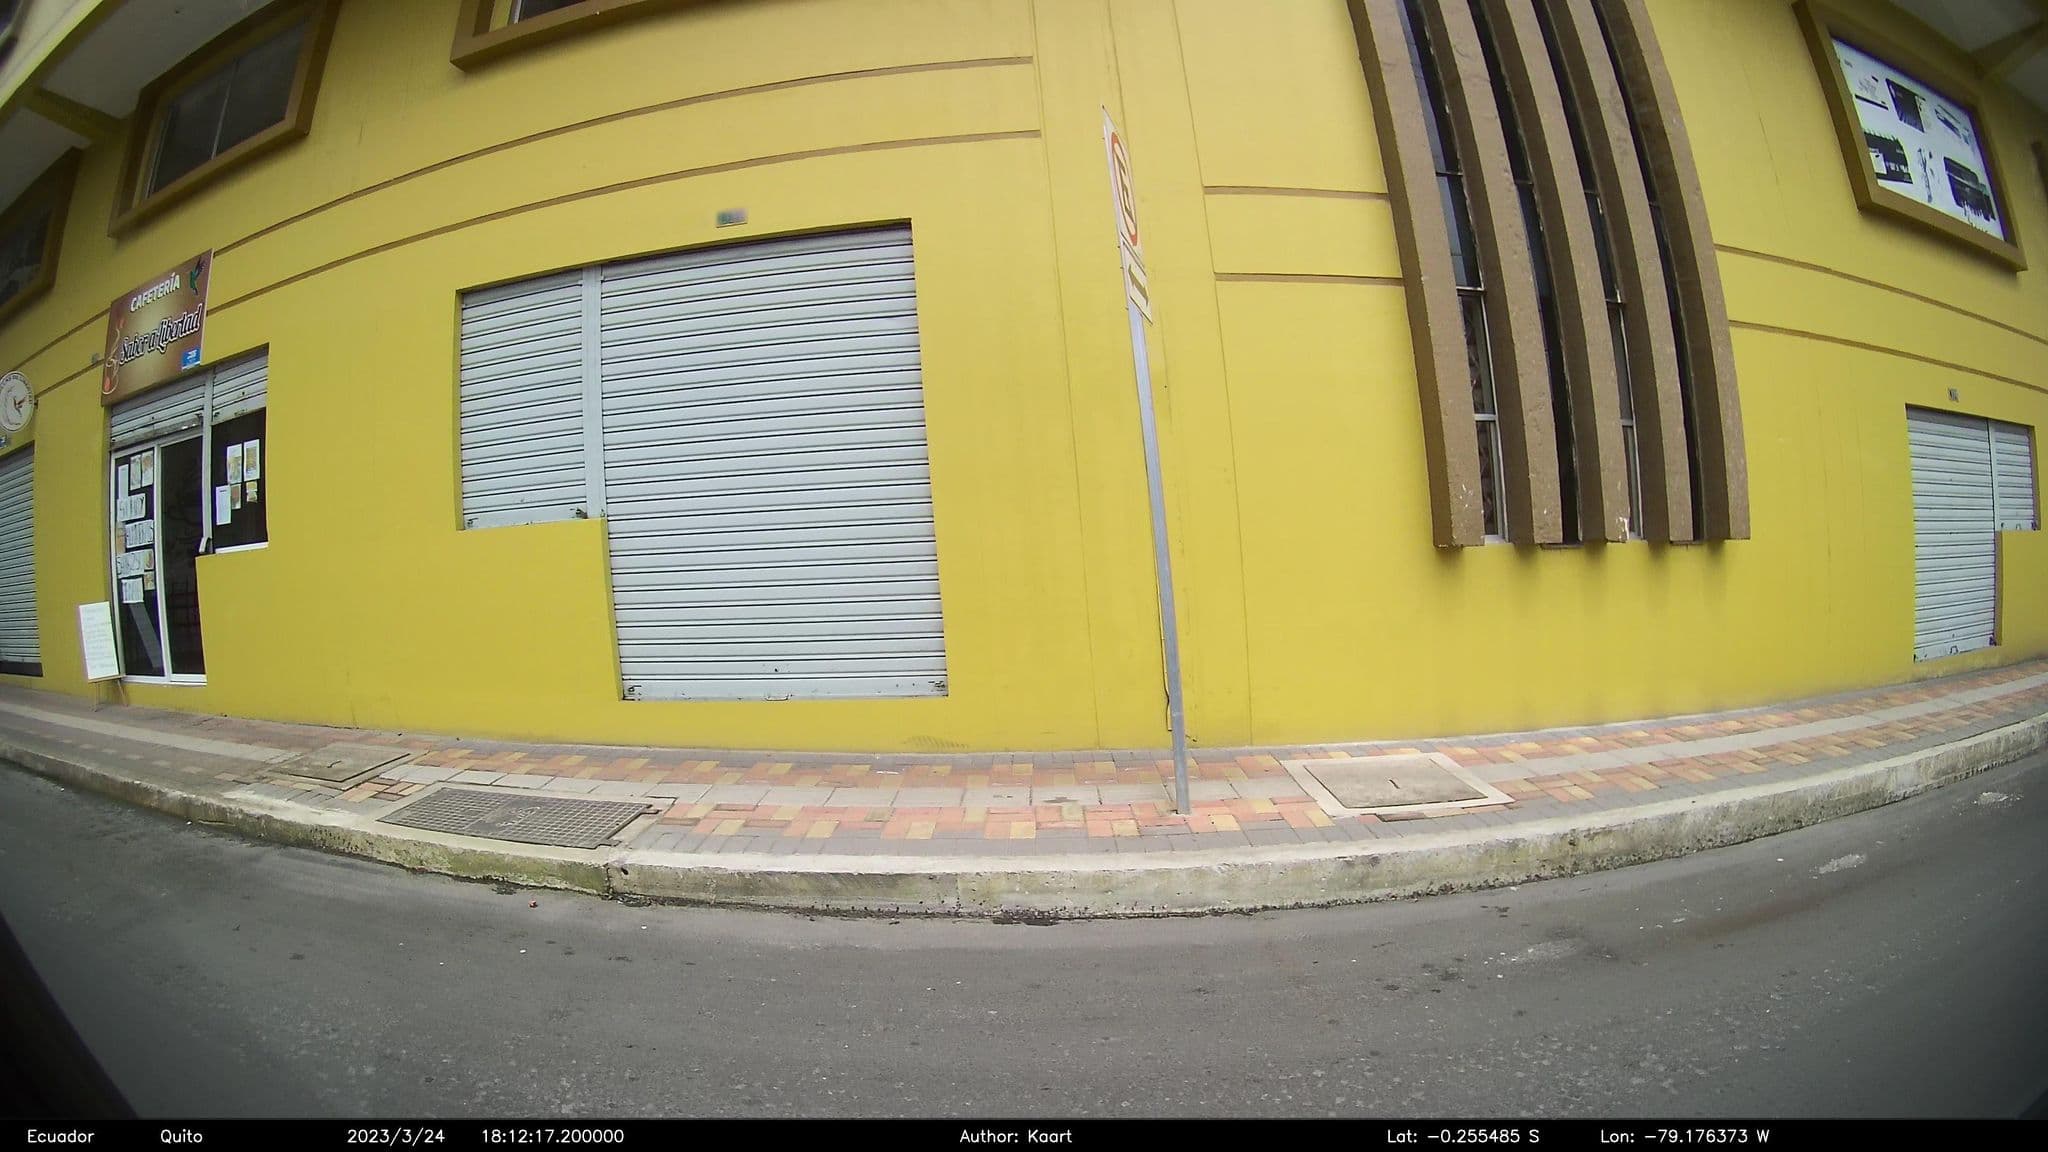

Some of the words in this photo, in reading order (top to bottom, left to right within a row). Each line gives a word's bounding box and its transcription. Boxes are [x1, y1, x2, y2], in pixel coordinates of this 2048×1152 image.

[130, 272, 180, 312] CAFETERÍA
[119, 333, 148, 365] Sabor
[156, 303, 203, 354] Libertad
